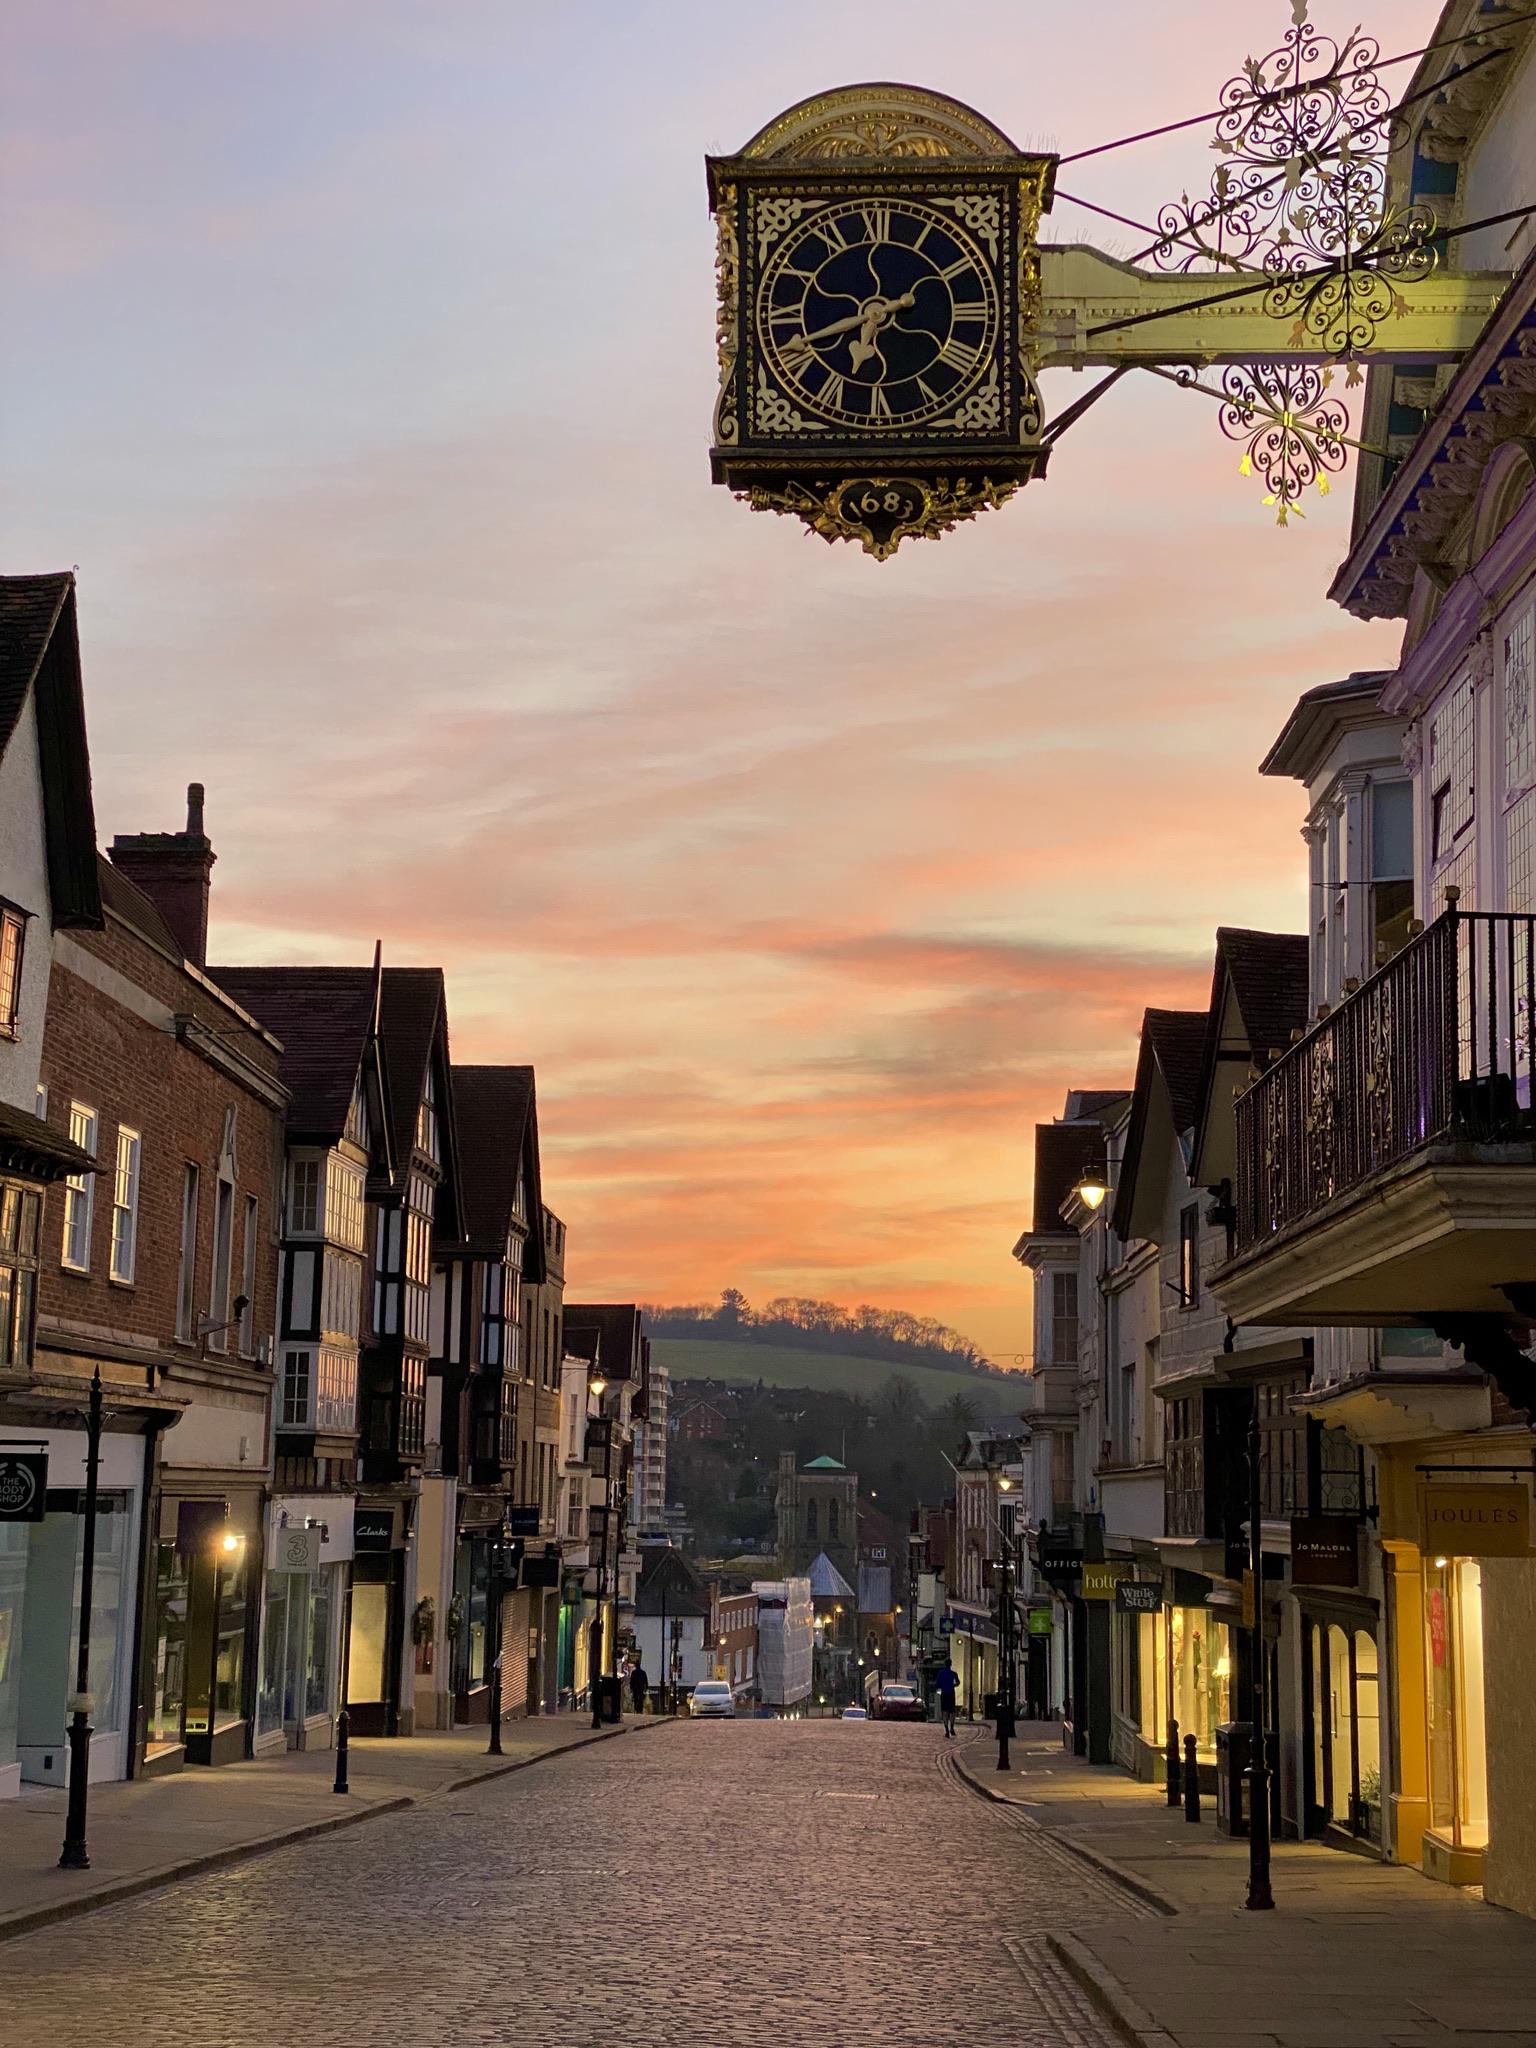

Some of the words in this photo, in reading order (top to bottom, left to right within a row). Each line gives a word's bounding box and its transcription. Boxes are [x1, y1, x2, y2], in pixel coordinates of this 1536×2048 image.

[849, 490, 914, 519] 1683
[3, 1477, 20, 1485] THE
[0, 1485, 26, 1494] ODY
[0, 1495, 24, 1504] HOP
[1430, 1508, 1519, 1523] JOULES
[356, 1527, 389, 1536] Clarks
[287, 1534, 309, 1562] 3
